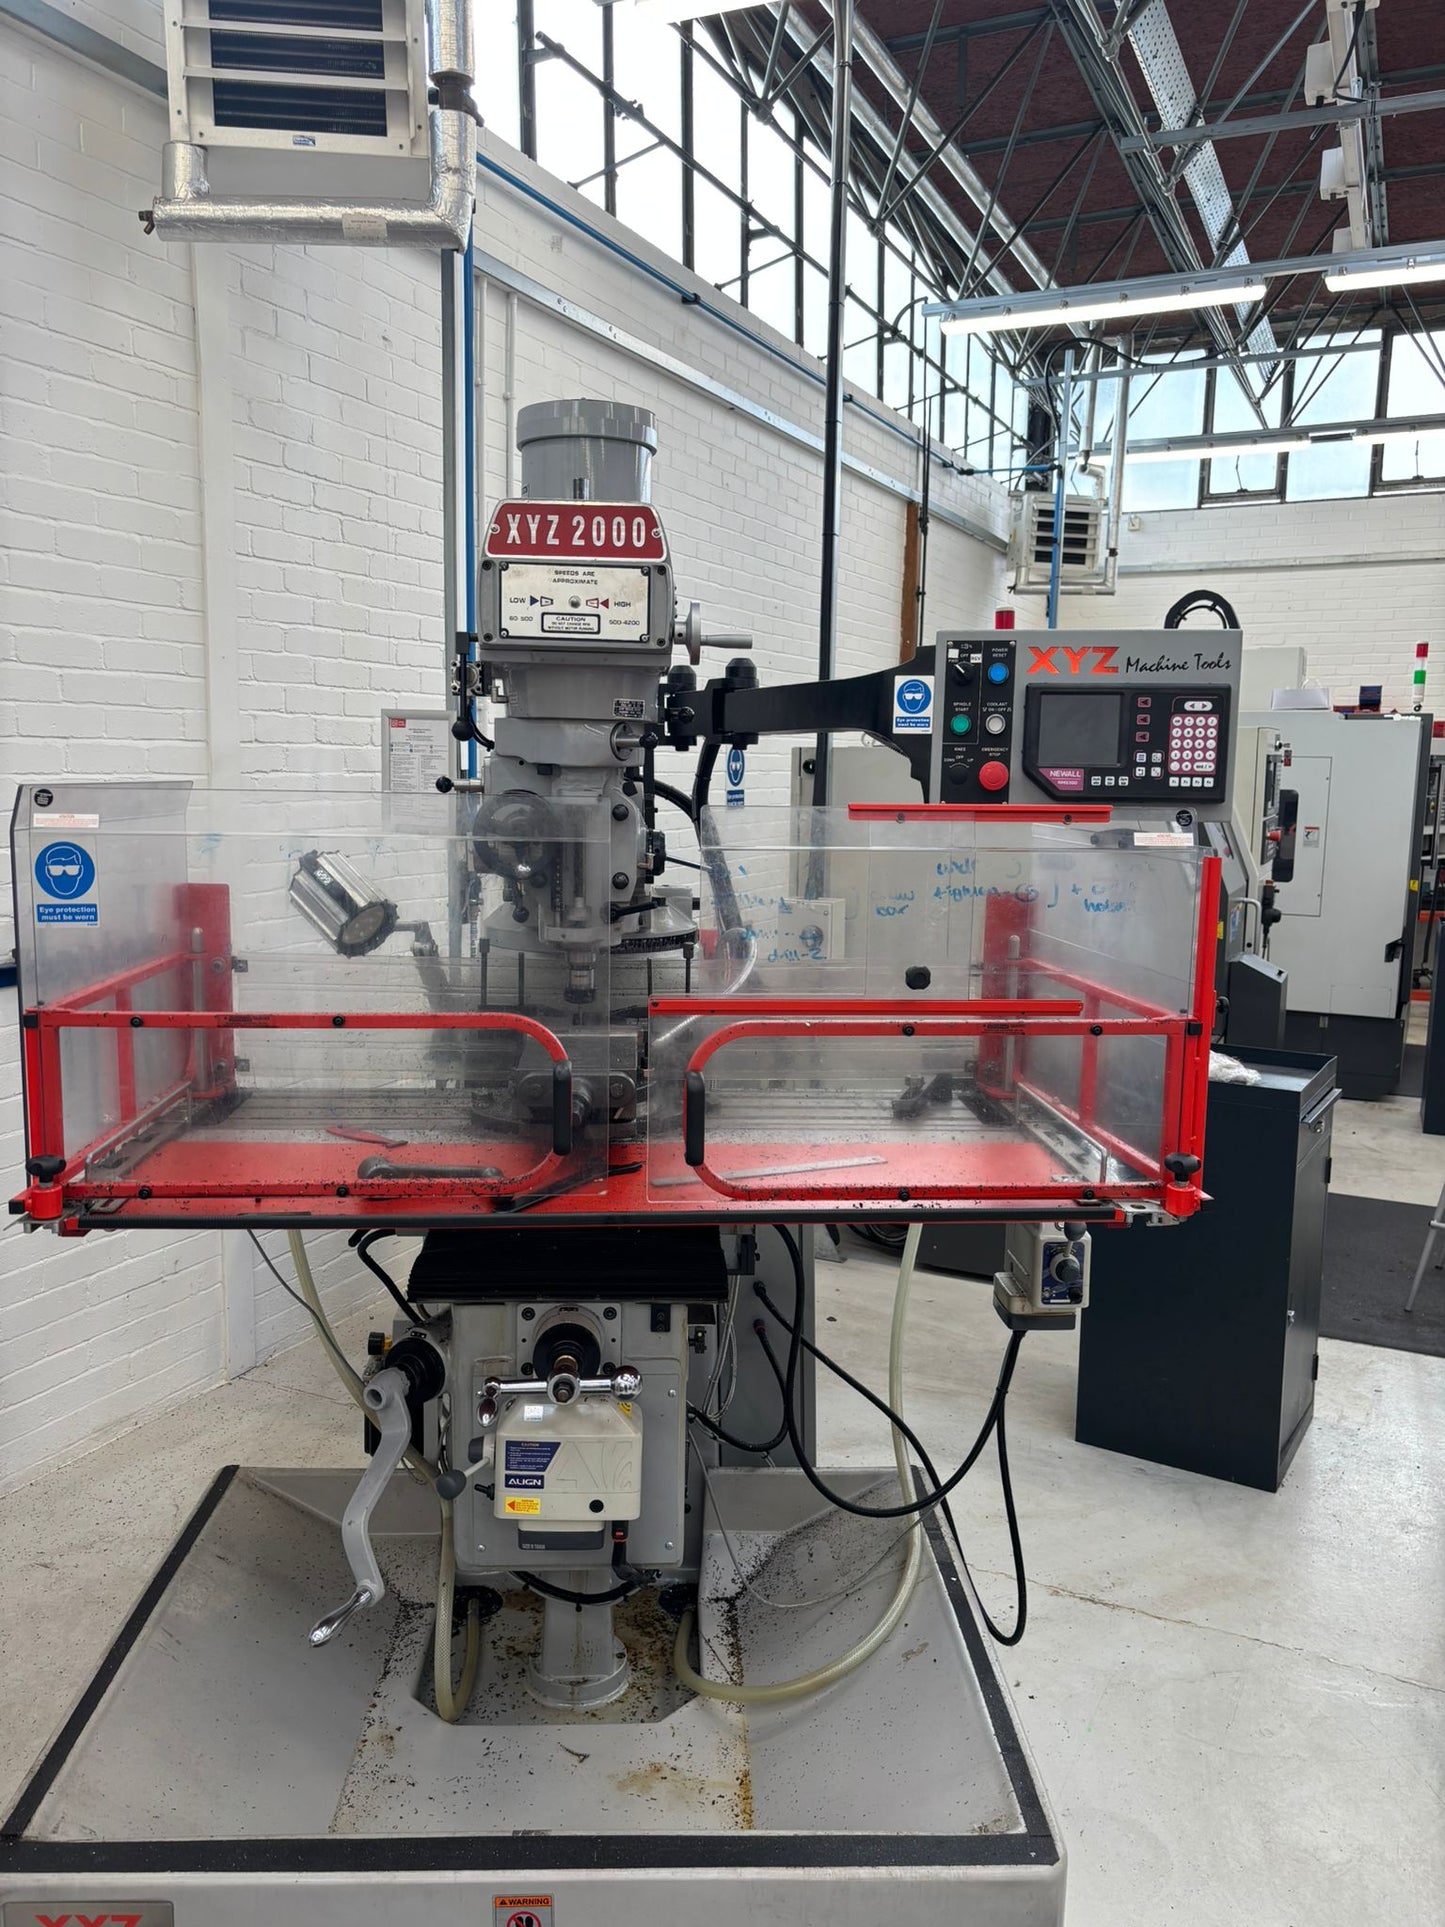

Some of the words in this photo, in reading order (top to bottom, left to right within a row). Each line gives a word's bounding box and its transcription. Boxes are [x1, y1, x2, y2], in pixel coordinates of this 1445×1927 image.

[506, 513, 560, 546] XYZ
[571, 515, 646, 548] 2000
[1026, 646, 1120, 675] XYZ
[1125, 656, 1189, 673] Machine
[1194, 652, 1232, 670] Tools
[39, 906, 54, 914] Eye
[55, 906, 96, 914] protection
[508, 1478, 542, 1486] ALIGN
[508, 1897, 549, 1906] WARNING
